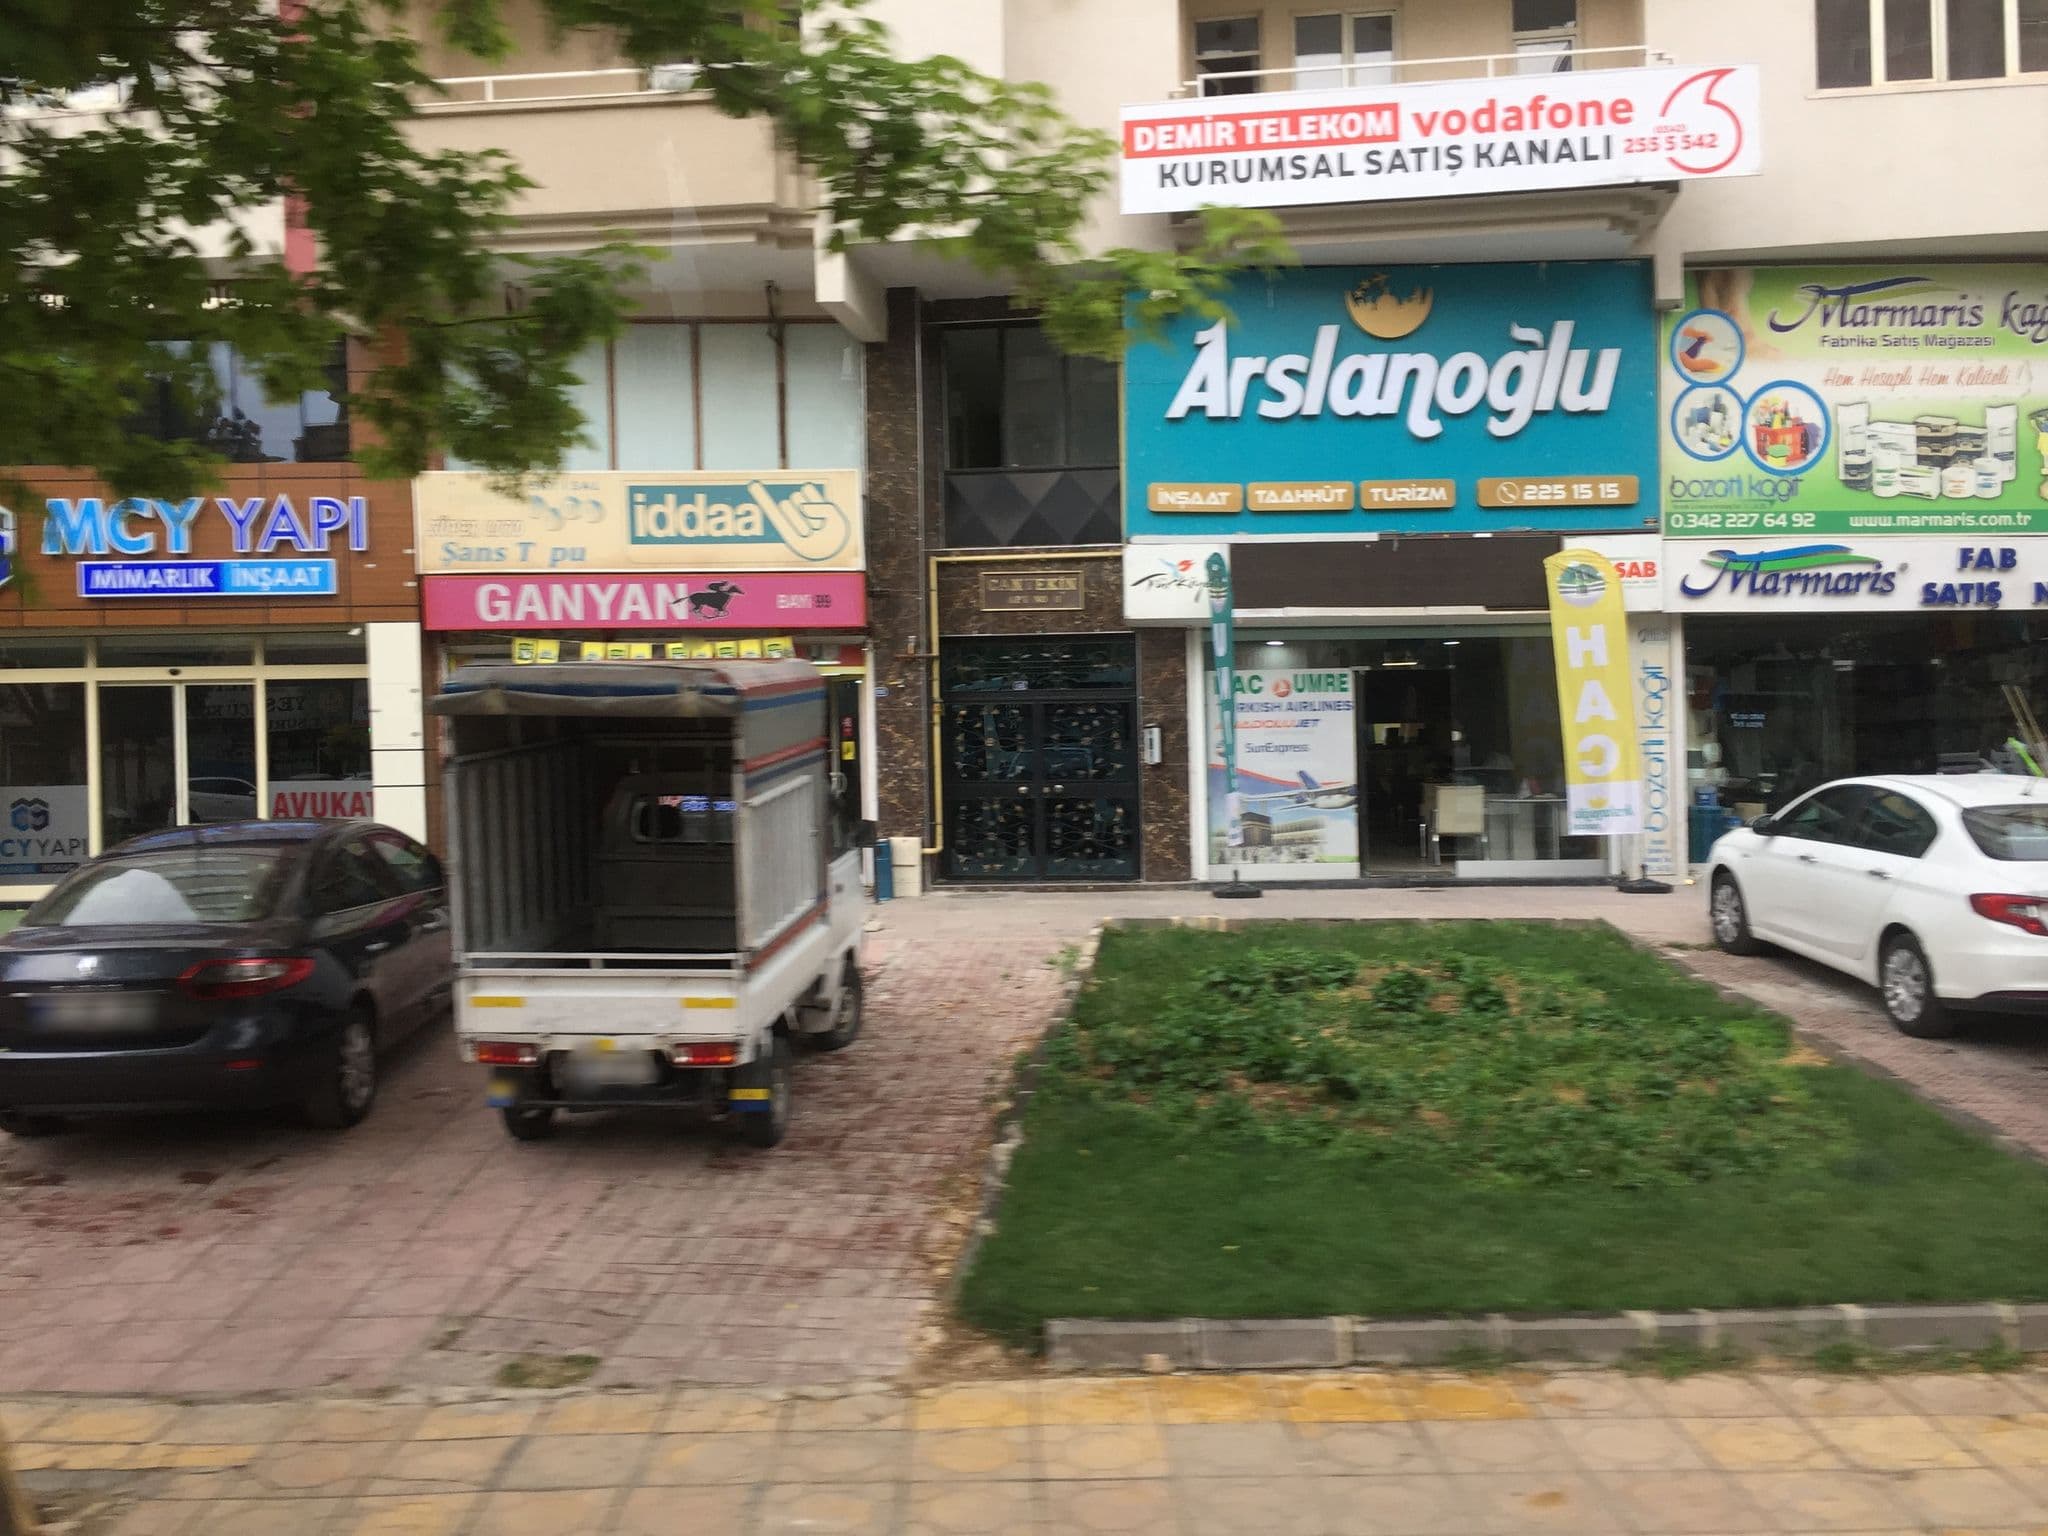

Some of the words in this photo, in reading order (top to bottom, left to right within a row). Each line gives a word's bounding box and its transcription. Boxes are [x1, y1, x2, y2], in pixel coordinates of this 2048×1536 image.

[1133, 118, 1237, 153] DEMİR
[1241, 106, 1394, 147] TELEKOM
[1412, 97, 1633, 137] vodafone
[1157, 151, 1353, 190] KURUMSAL
[1366, 142, 1464, 178] SATIŞ
[1477, 134, 1613, 168] KANALI
[1769, 283, 1985, 332] Marmaris
[1821, 335, 1876, 347] Fabrika
[1882, 335, 1920, 348] Satış
[1925, 334, 1995, 349] Mağazası
[1157, 488, 1231, 508] İNŞAAT
[1255, 486, 1347, 504] TAAHHÜT
[1370, 484, 1447, 502] TURİZM
[1523, 484, 1566, 499] 225
[1572, 483, 1592, 498] 15
[1598, 482, 1619, 498] 15
[41, 497, 205, 555] MCY
[215, 494, 370, 552] YAPI
[634, 493, 764, 537] iddaa
[1670, 513, 1722, 528] 0.342
[1725, 513, 1759, 527] 227
[1763, 513, 1788, 527] 64
[1792, 513, 1816, 527] 92
[1849, 512, 2031, 527] www.marmaris.com.tr
[1614, 561, 1657, 578] SAB
[1680, 547, 1898, 598] Marmaris
[1958, 547, 2017, 570] FAB
[89, 564, 215, 590] MİMARLIK
[231, 563, 322, 591] İNŞAAT
[474, 583, 689, 622] GANYAN
[1920, 581, 2002, 609] SATIŞ
[1293, 673, 1349, 694] UMRE
[1287, 700, 1354, 712] AIRLINES
[0, 838, 32, 857] CY
[36, 838, 87, 857] YAPI
